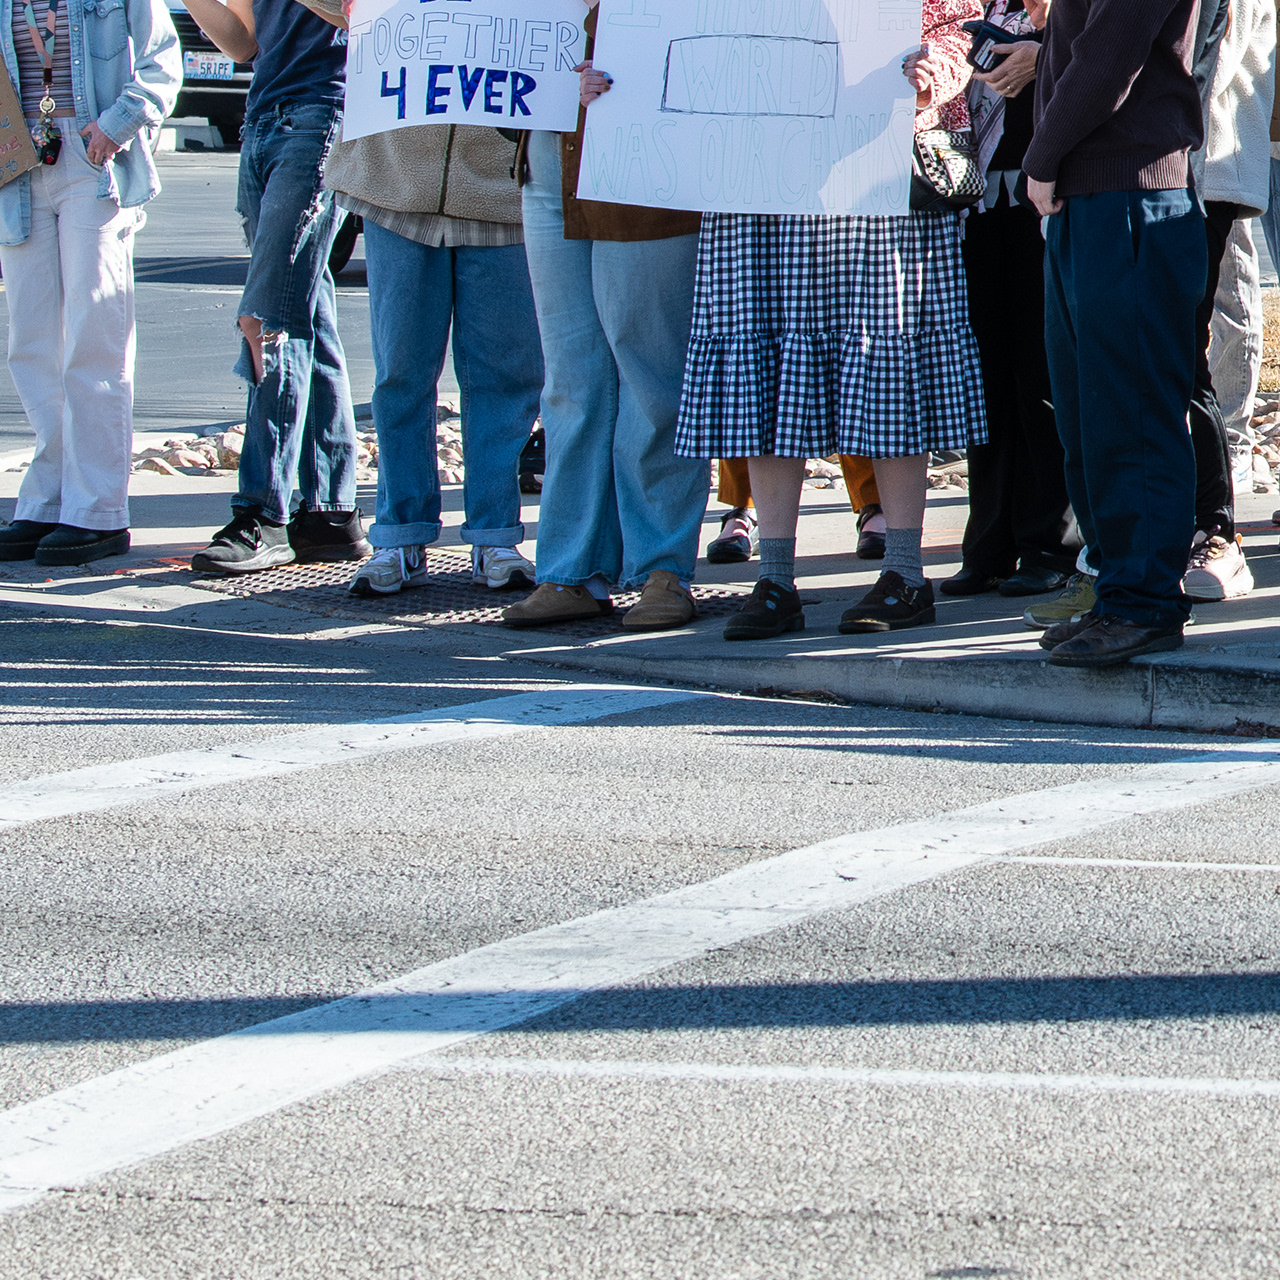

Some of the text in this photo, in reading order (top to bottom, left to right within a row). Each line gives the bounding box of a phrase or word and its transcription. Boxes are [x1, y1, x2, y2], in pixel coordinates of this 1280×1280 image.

[350, 12, 581, 74] TOGETHER
[680, 38, 835, 118] WORLD
[380, 64, 537, 120] 4 EVER
[586, 108, 913, 213] WAS OUR CAMPUS
